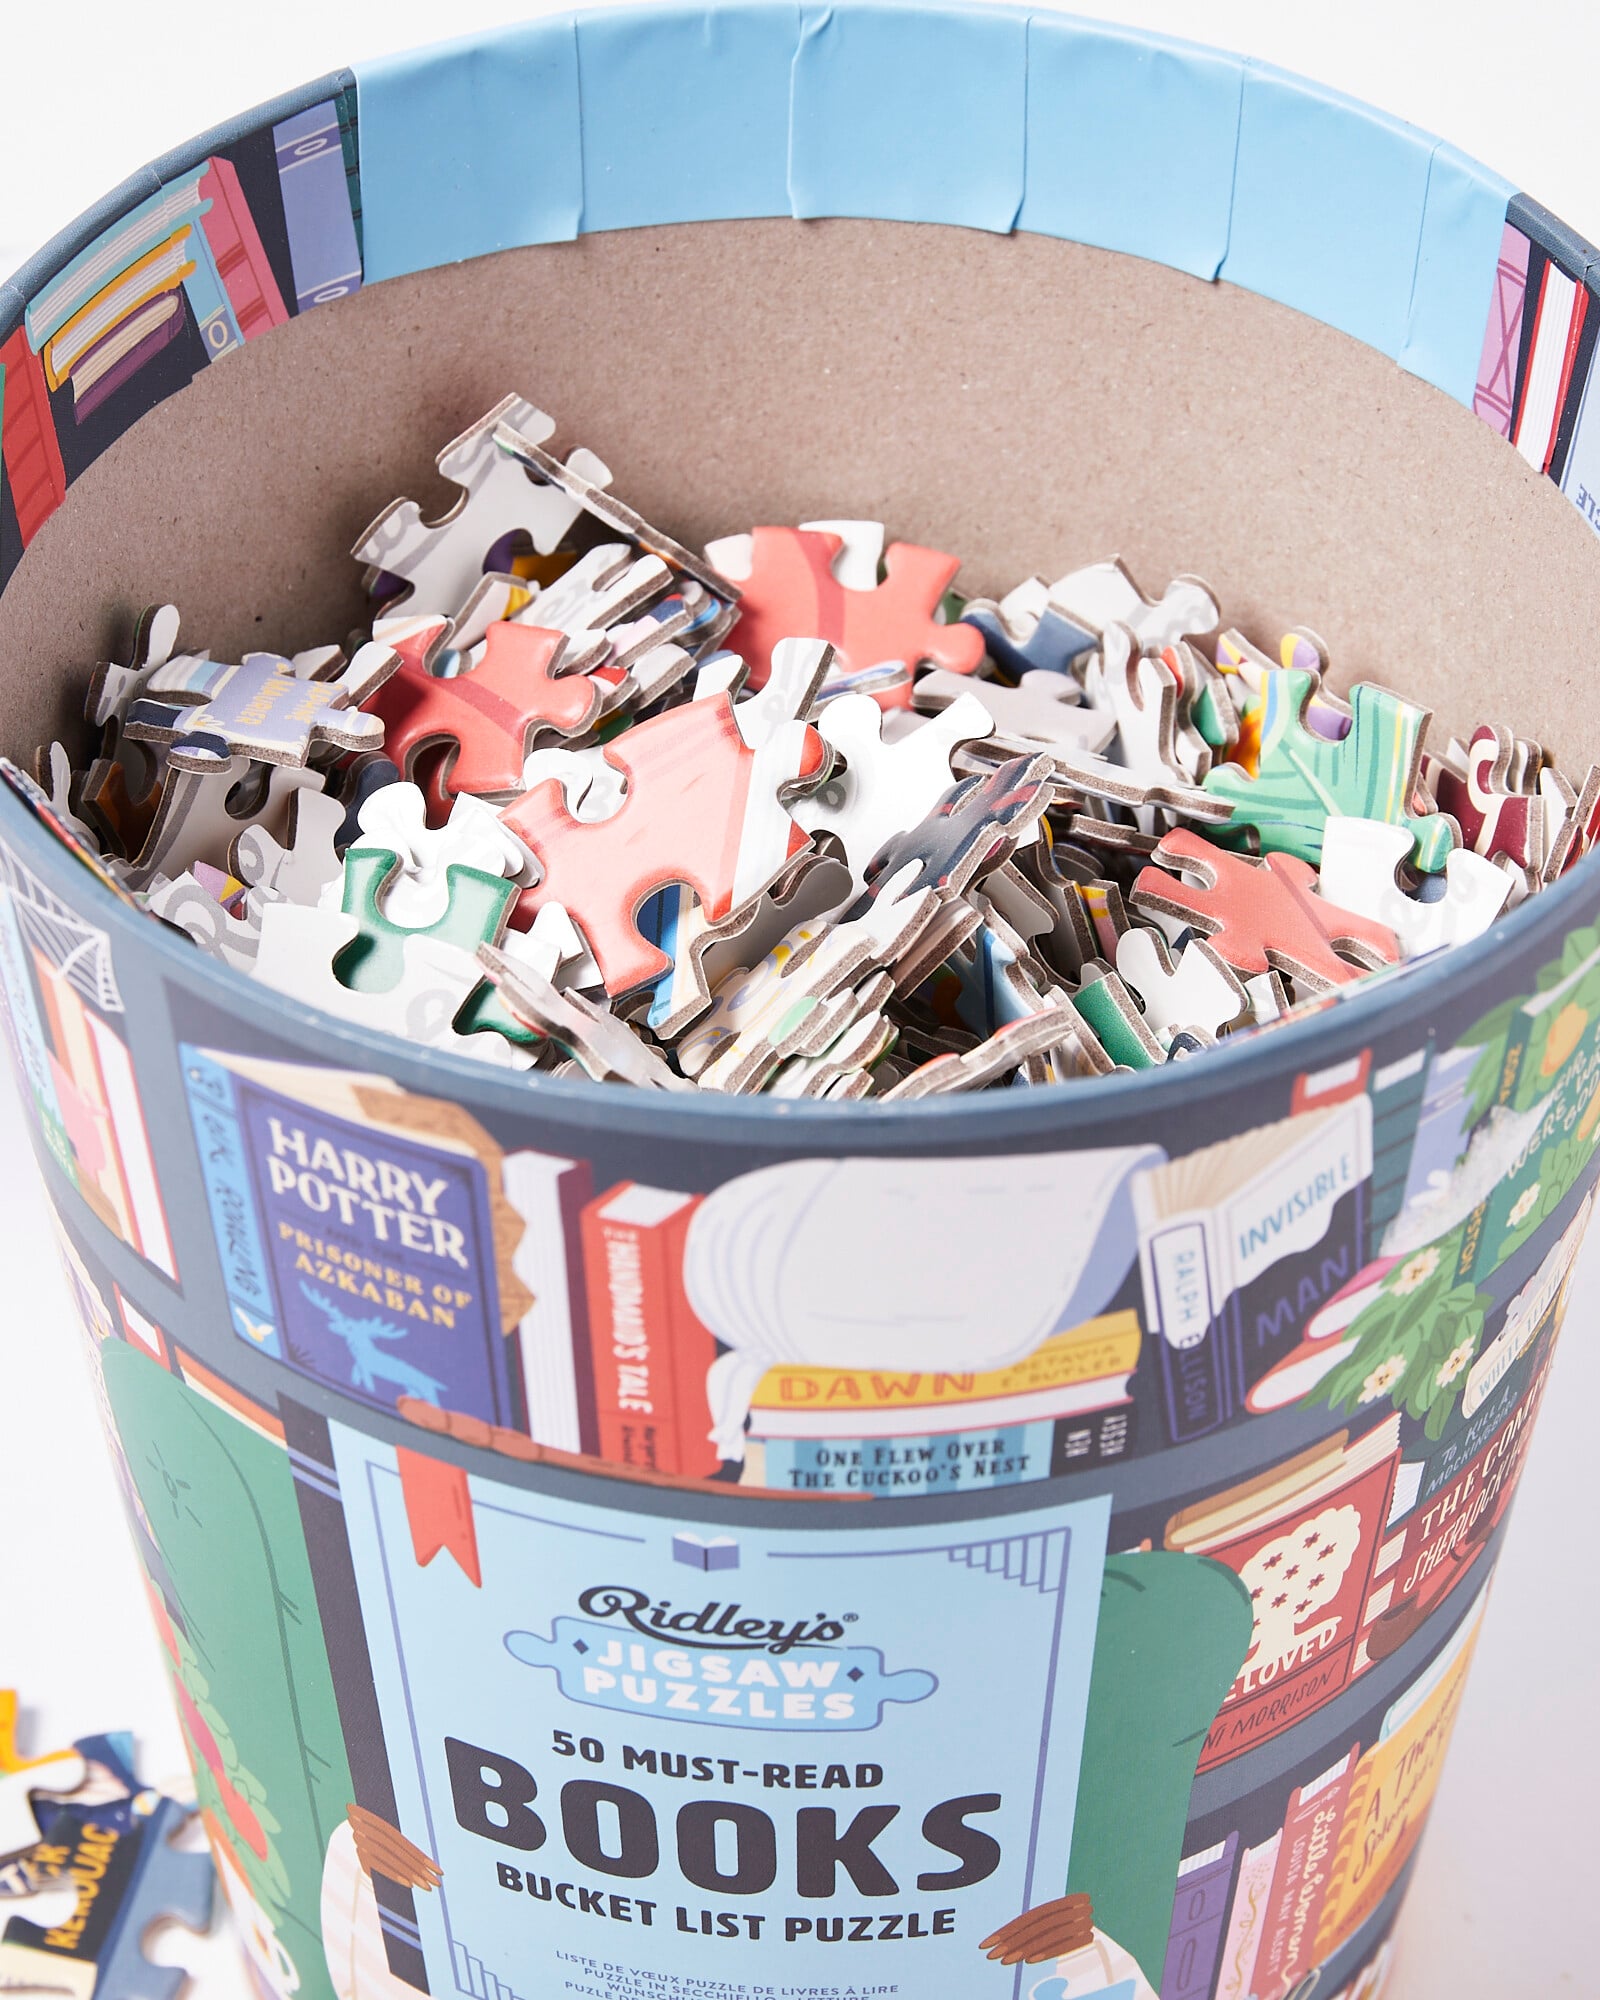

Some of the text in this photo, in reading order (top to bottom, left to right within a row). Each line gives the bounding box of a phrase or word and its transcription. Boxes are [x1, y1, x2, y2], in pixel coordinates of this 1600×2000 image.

[267, 1117, 448, 1216] HARRY
[266, 1155, 470, 1270] POTTER
[1237, 1154, 1353, 1260] INVISIBLE
[278, 1221, 425, 1296] PRISONER
[432, 1283, 473, 1309] OF
[295, 1253, 455, 1329] AZKABAN
[1258, 1244, 1350, 1346] MAN
[1173, 1248, 1209, 1421] RALPH ELLISON
[617, 1364, 654, 1415] TALE
[778, 1372, 976, 1402] DAWN
[816, 1438, 1006, 1468] ONE FLEW OVER
[1464, 1405, 1497, 1446] KILL
[788, 1455, 1031, 1489] THE CUCKOO'S NEST
[1420, 1462, 1481, 1542] THE
[583, 1668, 856, 1720] PUZZLES
[596, 1640, 841, 1689] JIGSAW
[1223, 1615, 1343, 1703] LOVED
[1230, 1659, 1340, 1740] MORRISON
[551, 1729, 885, 1789] 50 MUST-READ
[444, 1736, 1002, 1899] BOOKS
[1303, 1804, 1337, 1880] Little
[1286, 1833, 1307, 1887] LOUISA
[496, 1861, 957, 1943] BUCKET LIST PUZZLE
[555, 1950, 598, 1969] LISTE
[603, 1963, 625, 1974] DE
[686, 1978, 746, 1993] PUZZLE
[753, 1986, 775, 1995] DE
[781, 1987, 840, 1996] LIVRES
[862, 1984, 900, 1995] LIRE
[564, 1980, 613, 1999] PUZLE
[584, 1967, 642, 1988] PUZZLE
[649, 1981, 666, 1992] IN
